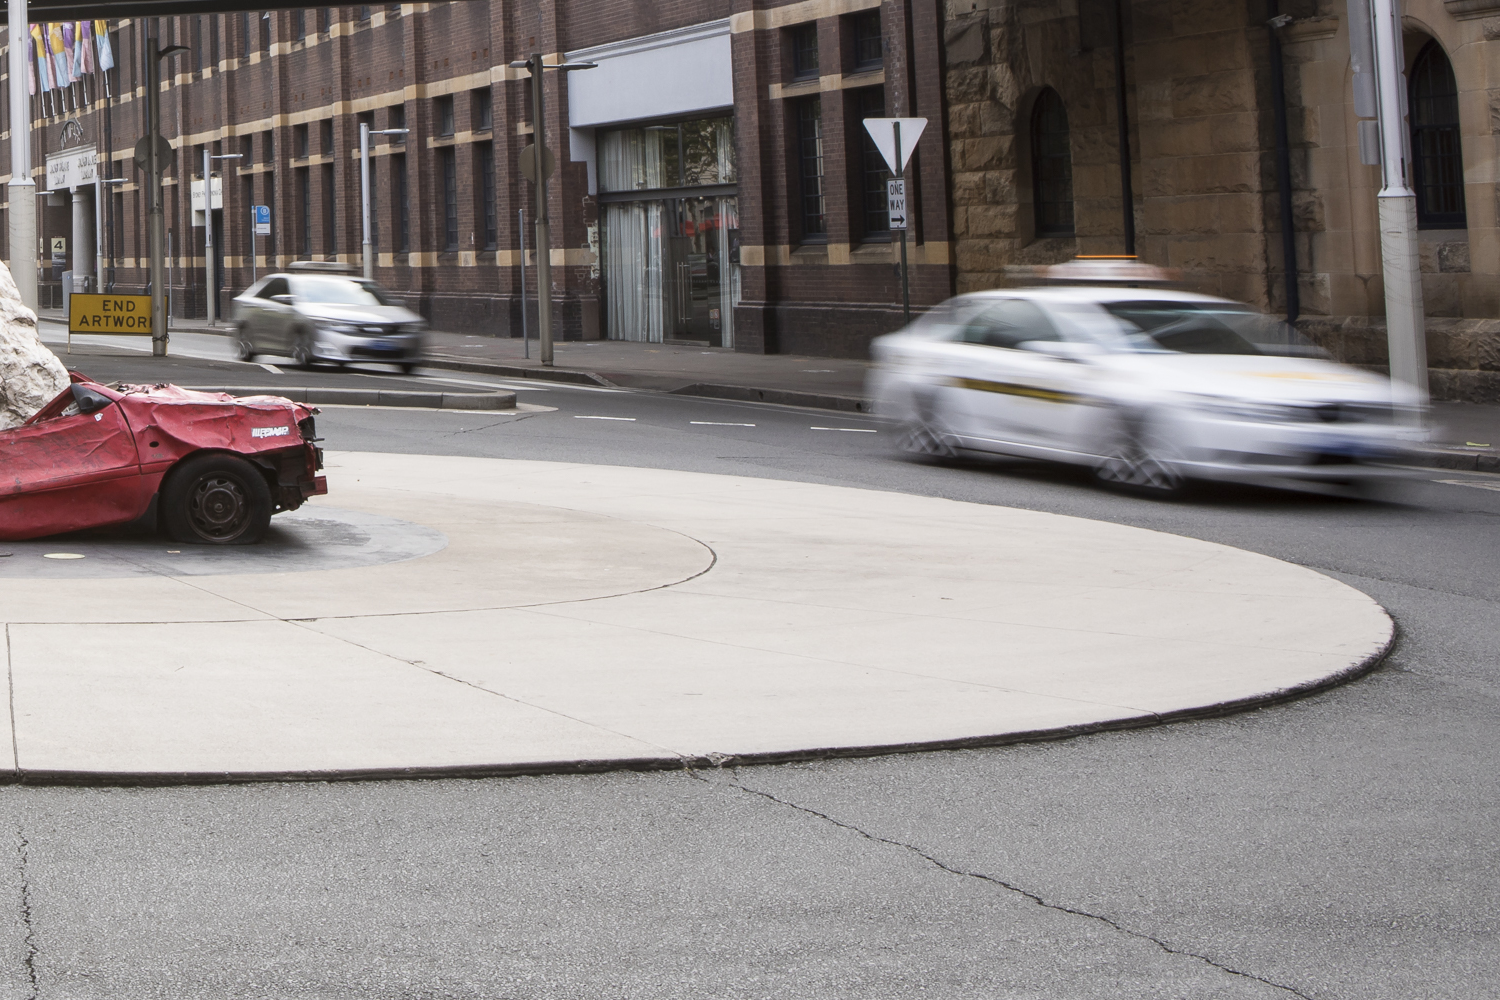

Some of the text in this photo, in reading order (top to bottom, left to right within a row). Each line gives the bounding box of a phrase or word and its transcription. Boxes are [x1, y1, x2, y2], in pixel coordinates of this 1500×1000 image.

[890, 184, 903, 195] ONE
[890, 199, 904, 210] WAY
[54, 240, 63, 249] 4
[102, 299, 136, 312] END
